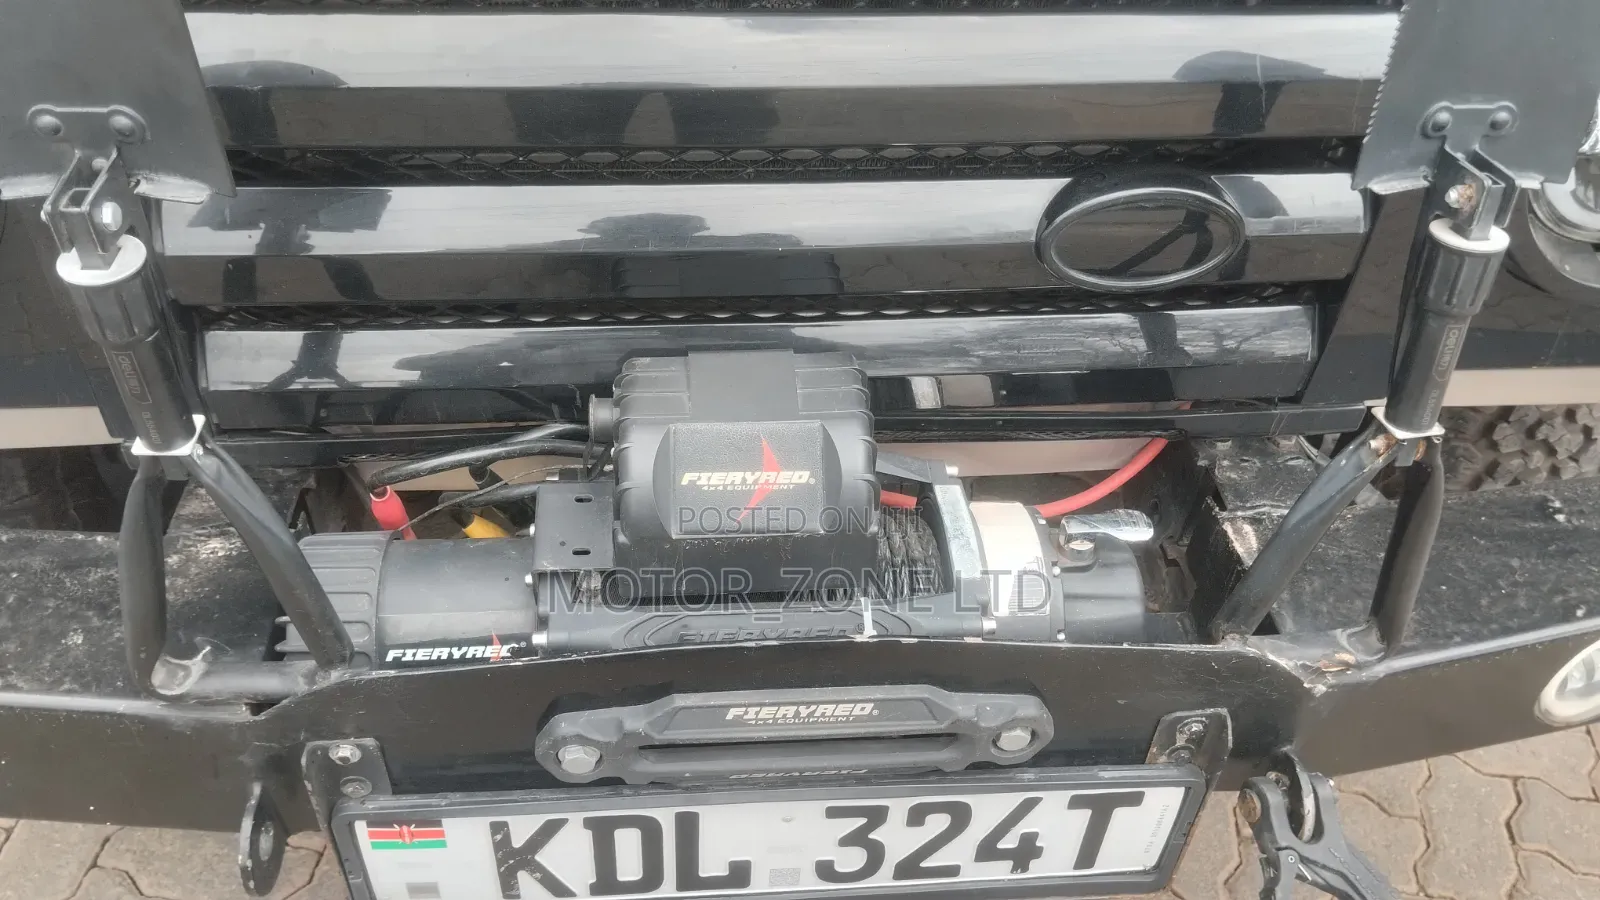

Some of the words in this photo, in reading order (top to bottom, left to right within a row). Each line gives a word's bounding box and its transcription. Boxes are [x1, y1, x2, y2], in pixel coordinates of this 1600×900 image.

[777, 716, 856, 724] EQUIPMENT
[489, 810, 752, 899] KDL
[814, 790, 1146, 884] 324T
